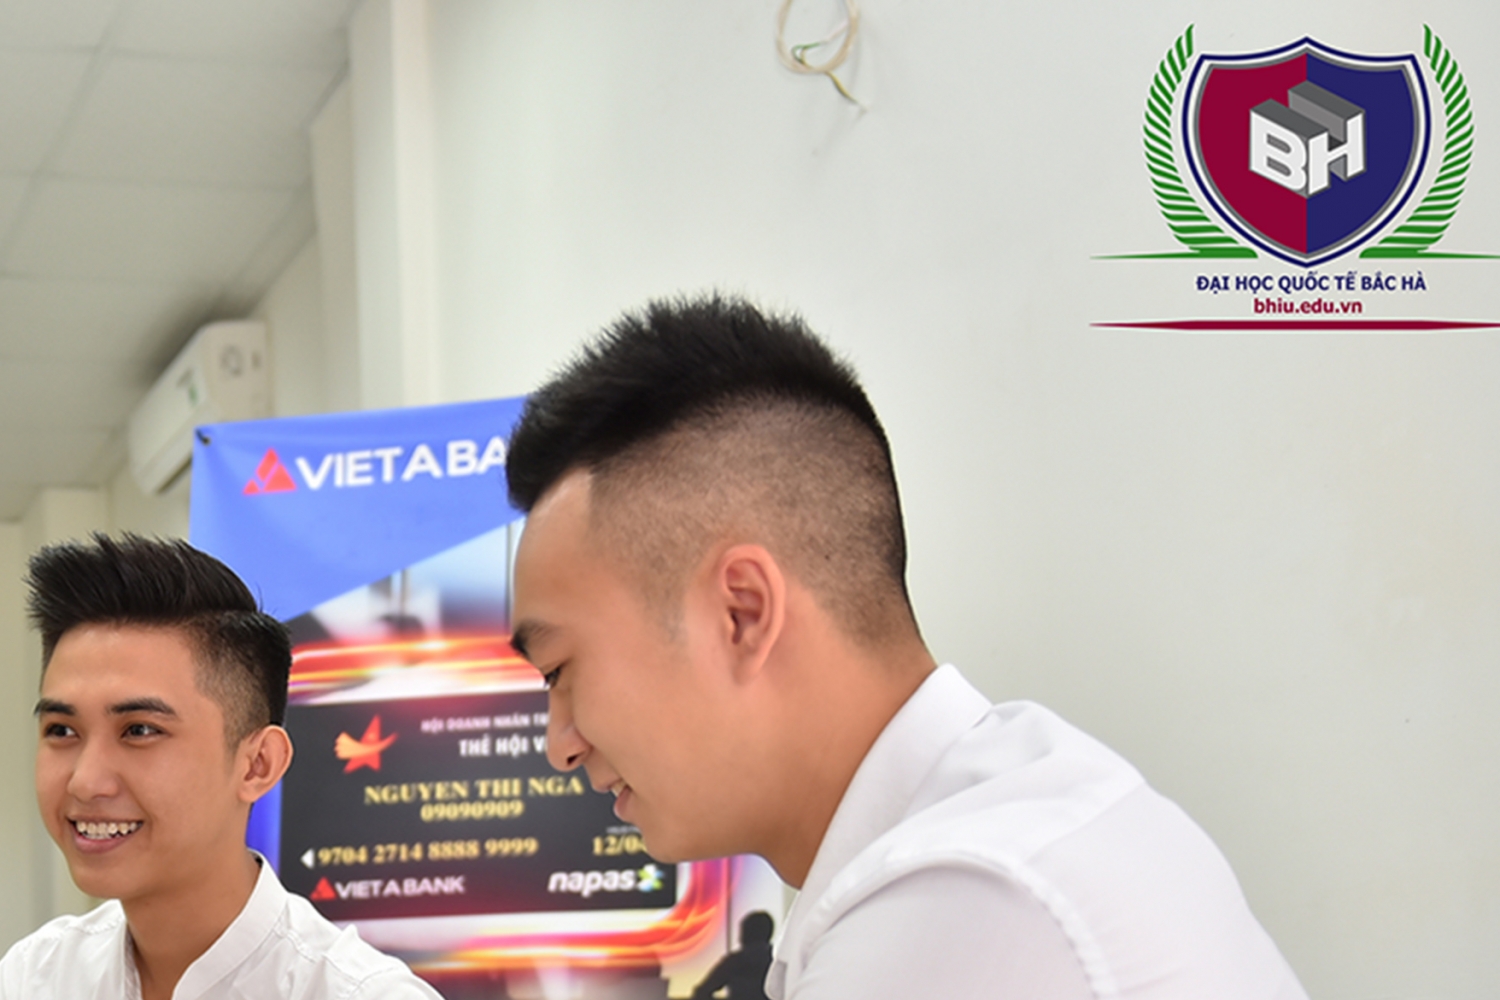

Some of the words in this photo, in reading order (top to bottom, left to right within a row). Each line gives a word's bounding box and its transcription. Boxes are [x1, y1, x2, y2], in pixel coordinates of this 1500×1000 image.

[495, 733, 529, 759] HỘI
[364, 780, 470, 804] NGUYEN
[474, 777, 522, 799] THI
[527, 775, 585, 797] NGA
[420, 799, 525, 822] 09090909
[317, 845, 369, 865] 9704
[373, 842, 424, 864] 2714
[427, 839, 481, 861] 8888
[484, 836, 539, 857] 9999
[547, 869, 636, 897] napas
